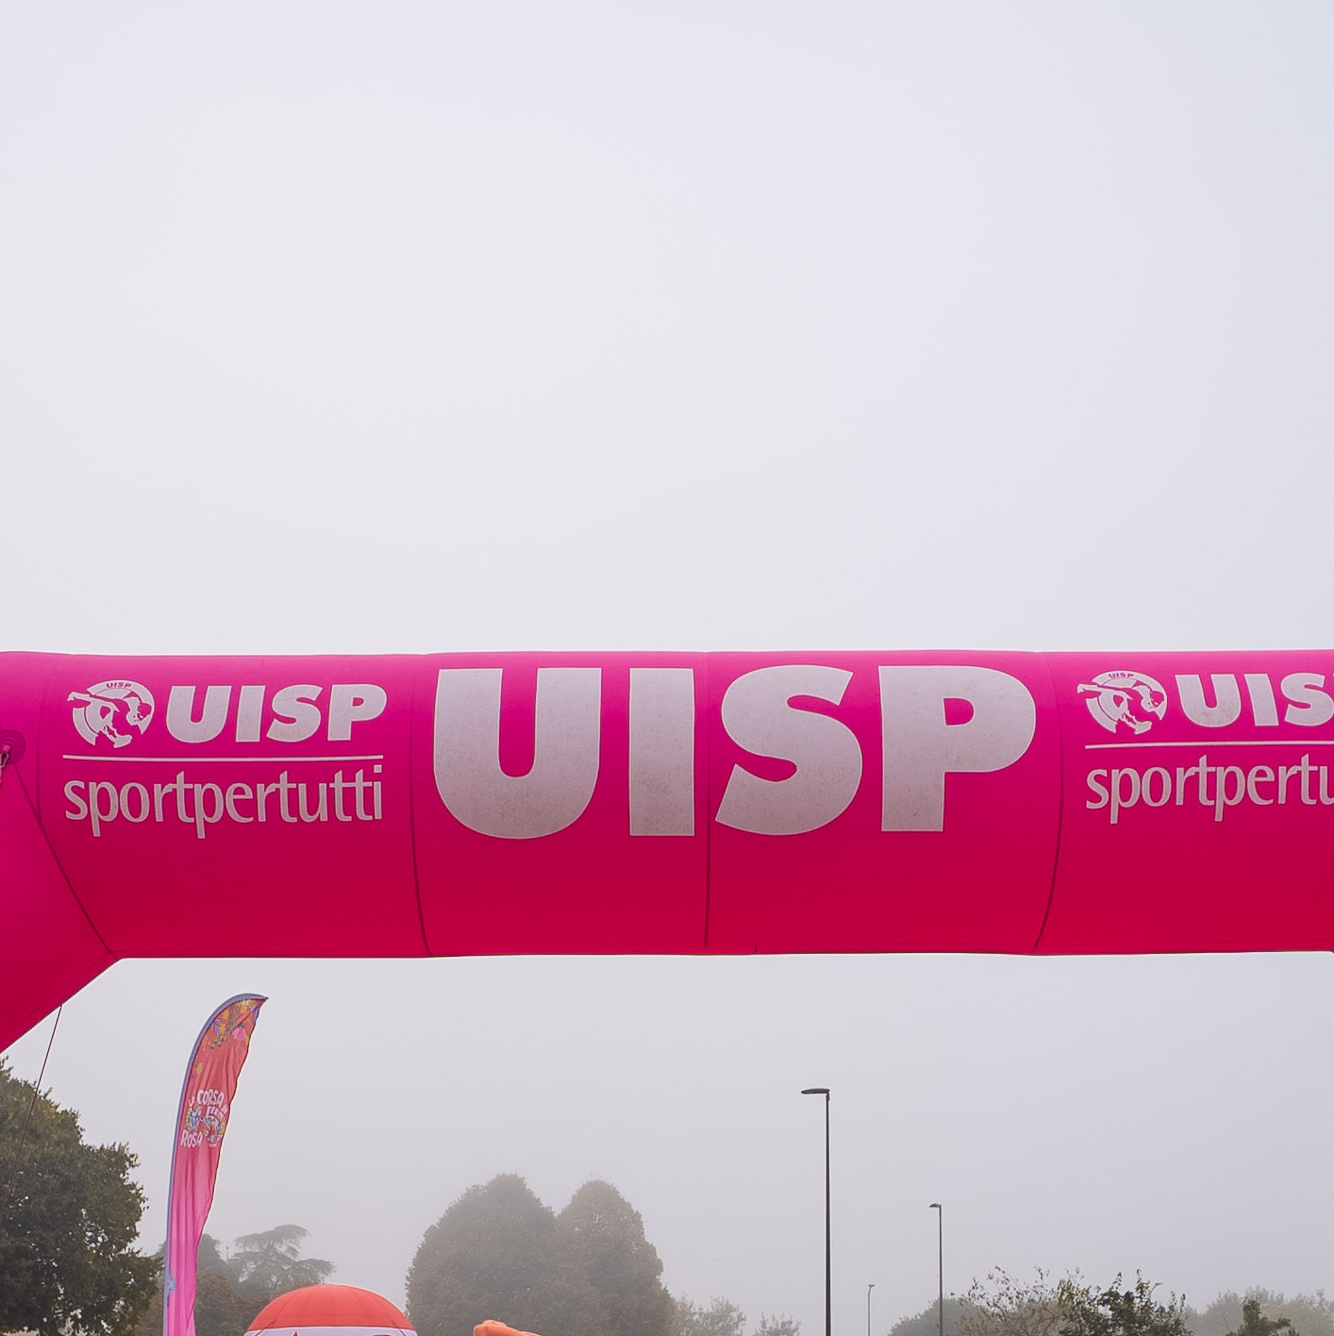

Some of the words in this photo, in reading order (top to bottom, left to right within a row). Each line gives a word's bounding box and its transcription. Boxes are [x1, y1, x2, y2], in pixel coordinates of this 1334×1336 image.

[106, 681, 132, 690] UISP
[165, 684, 388, 744] UISP
[433, 664, 1037, 839] UISP
[63, 764, 383, 839] sportpertutti
[180, 1129, 203, 1148] ROSA
